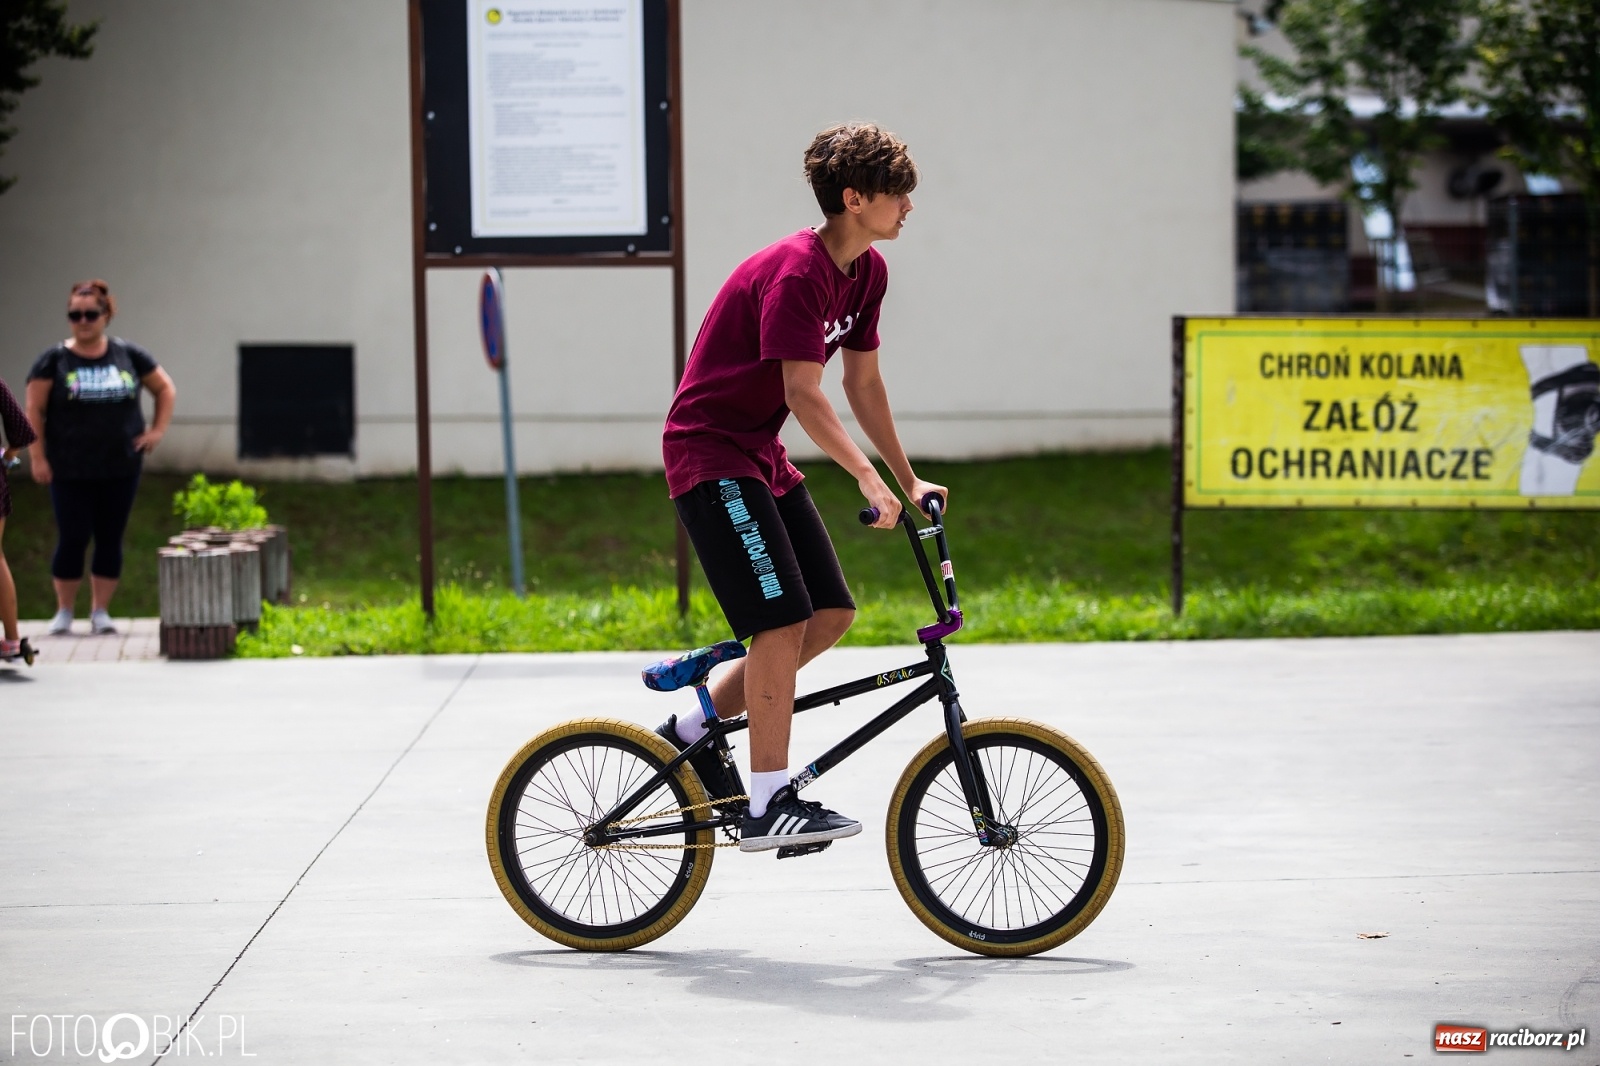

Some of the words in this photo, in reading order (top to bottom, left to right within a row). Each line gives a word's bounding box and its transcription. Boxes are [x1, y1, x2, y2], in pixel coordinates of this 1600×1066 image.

[1259, 346, 1351, 380] CHROŃ
[1360, 352, 1464, 381] KOLANA
[1302, 391, 1419, 433] ZAŁÓŻ
[1230, 446, 1492, 480] OCHRANIACZE
